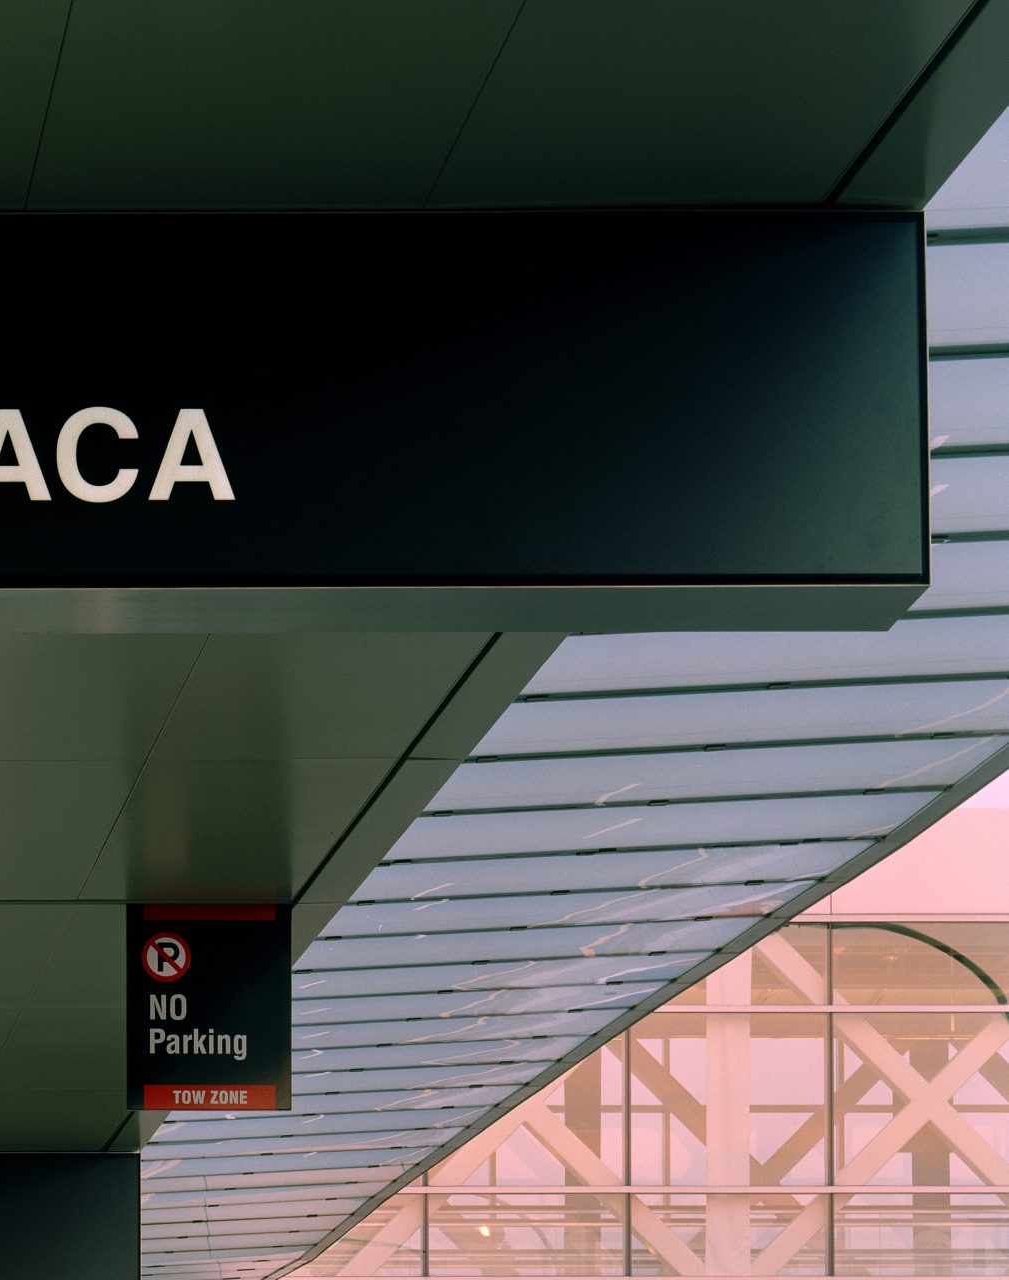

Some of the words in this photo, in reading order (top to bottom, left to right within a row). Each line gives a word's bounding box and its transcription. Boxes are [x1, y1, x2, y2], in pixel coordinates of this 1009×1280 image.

[149, 993, 188, 1021] NO
[149, 1028, 248, 1061] Parking
[173, 1090, 207, 1105] TOW
[210, 1090, 248, 1105] ZONE
